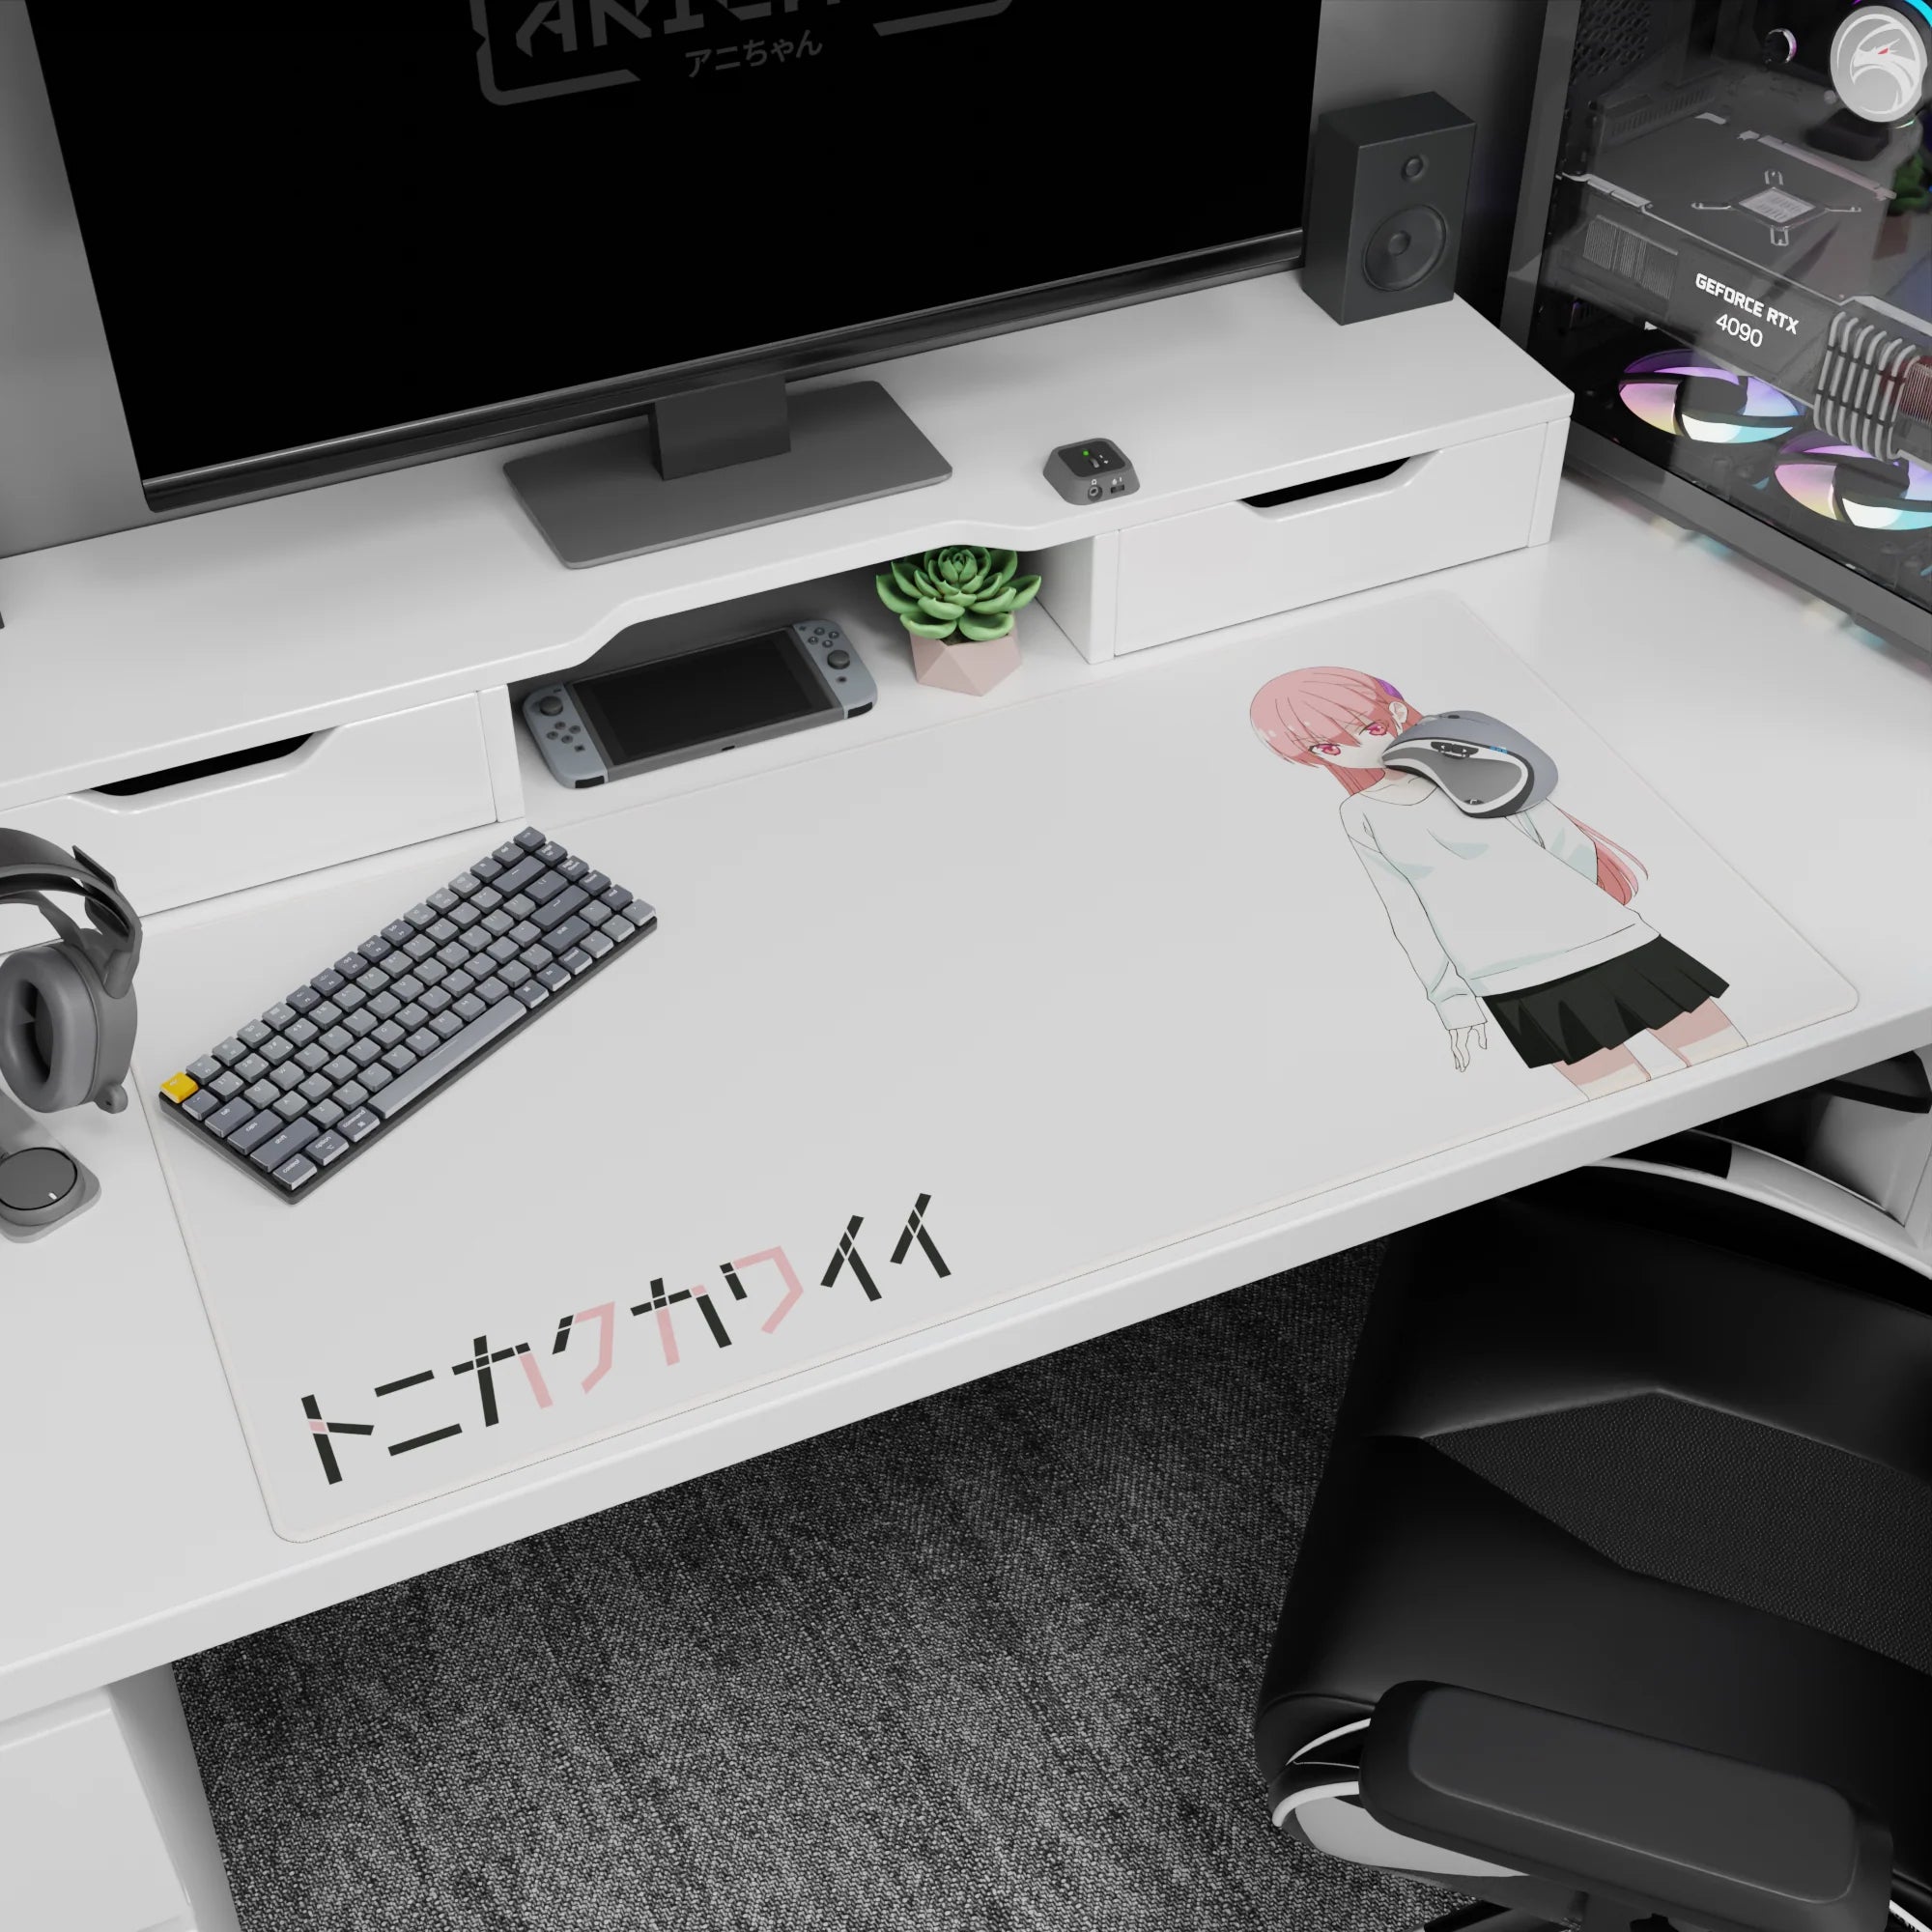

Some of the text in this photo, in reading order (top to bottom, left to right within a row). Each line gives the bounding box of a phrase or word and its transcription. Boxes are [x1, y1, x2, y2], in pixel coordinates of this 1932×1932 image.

[685, 29, 824, 78] アニちゃん
[1695, 272, 1800, 334] GEFORCE RTX
[1715, 313, 1764, 349] 4090
[342, 1109, 366, 1127] command
[282, 1158, 300, 1174] control
[300, 1192, 952, 1486] トニカクカワイイ
